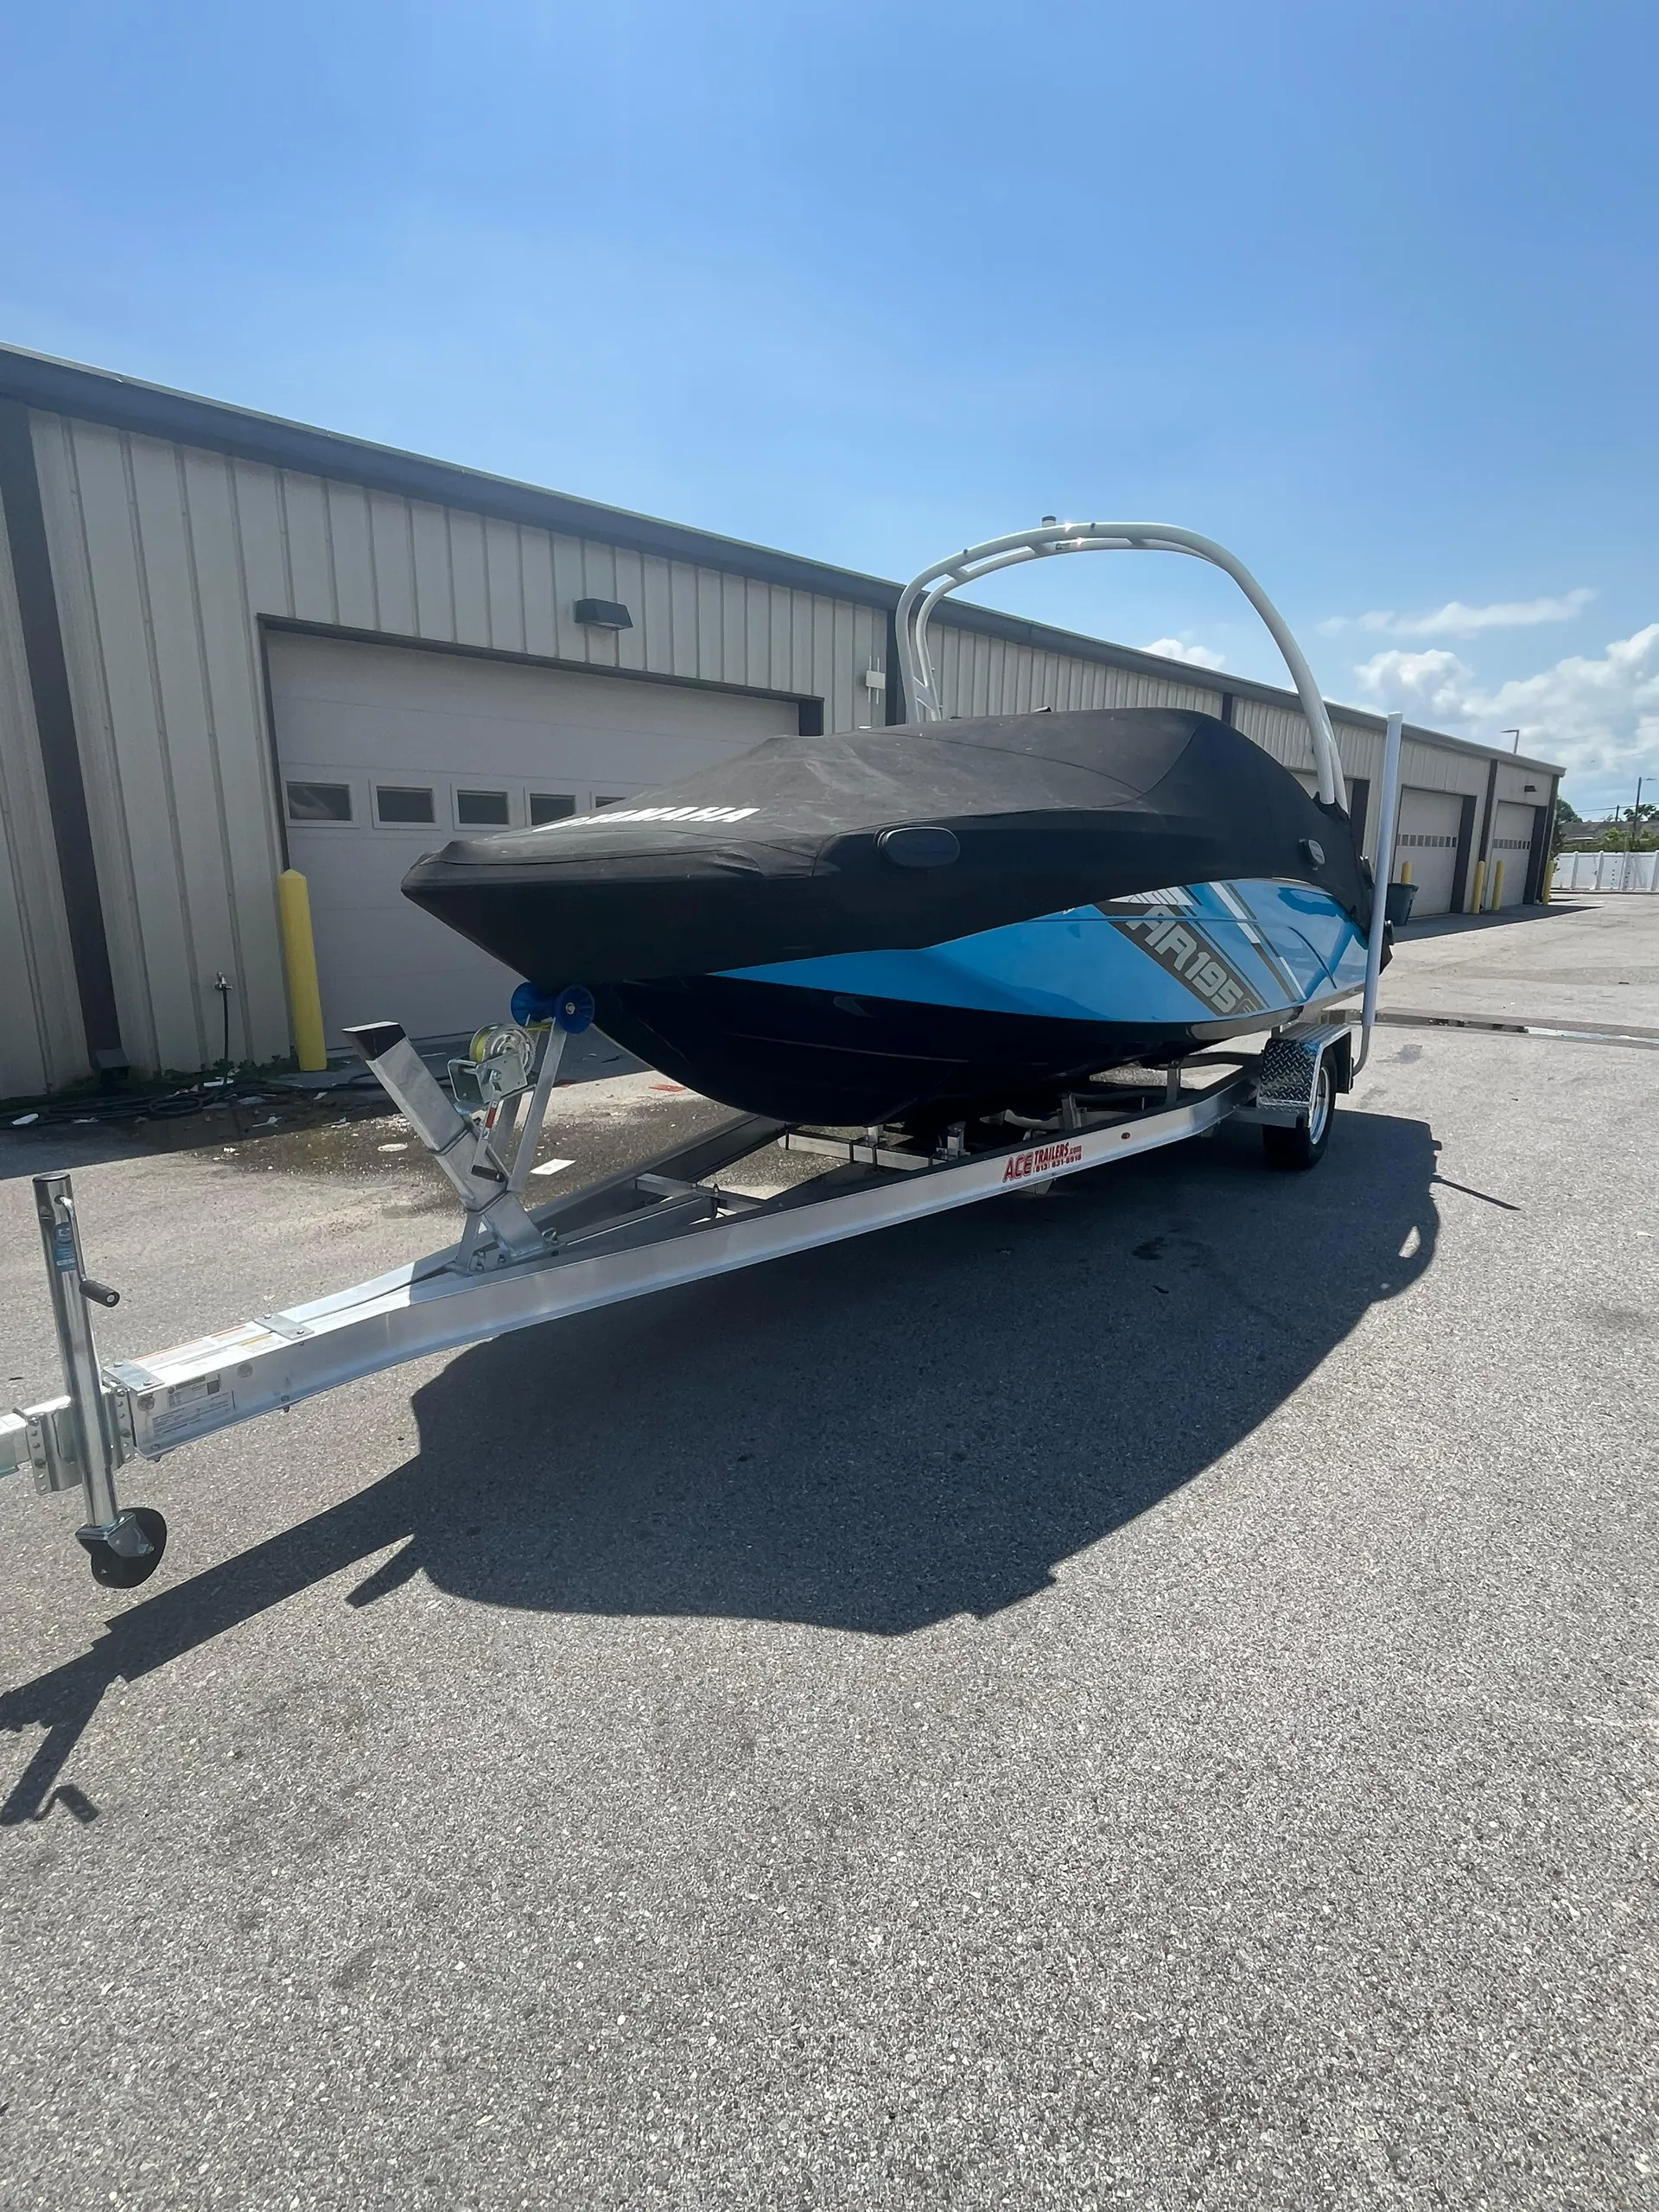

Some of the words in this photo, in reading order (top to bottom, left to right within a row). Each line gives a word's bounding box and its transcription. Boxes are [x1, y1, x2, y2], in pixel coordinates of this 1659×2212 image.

[572, 807, 760, 827] YAMAHA
[1125, 906, 1244, 1013] AR195
[1002, 1153, 1034, 1183] ACE
